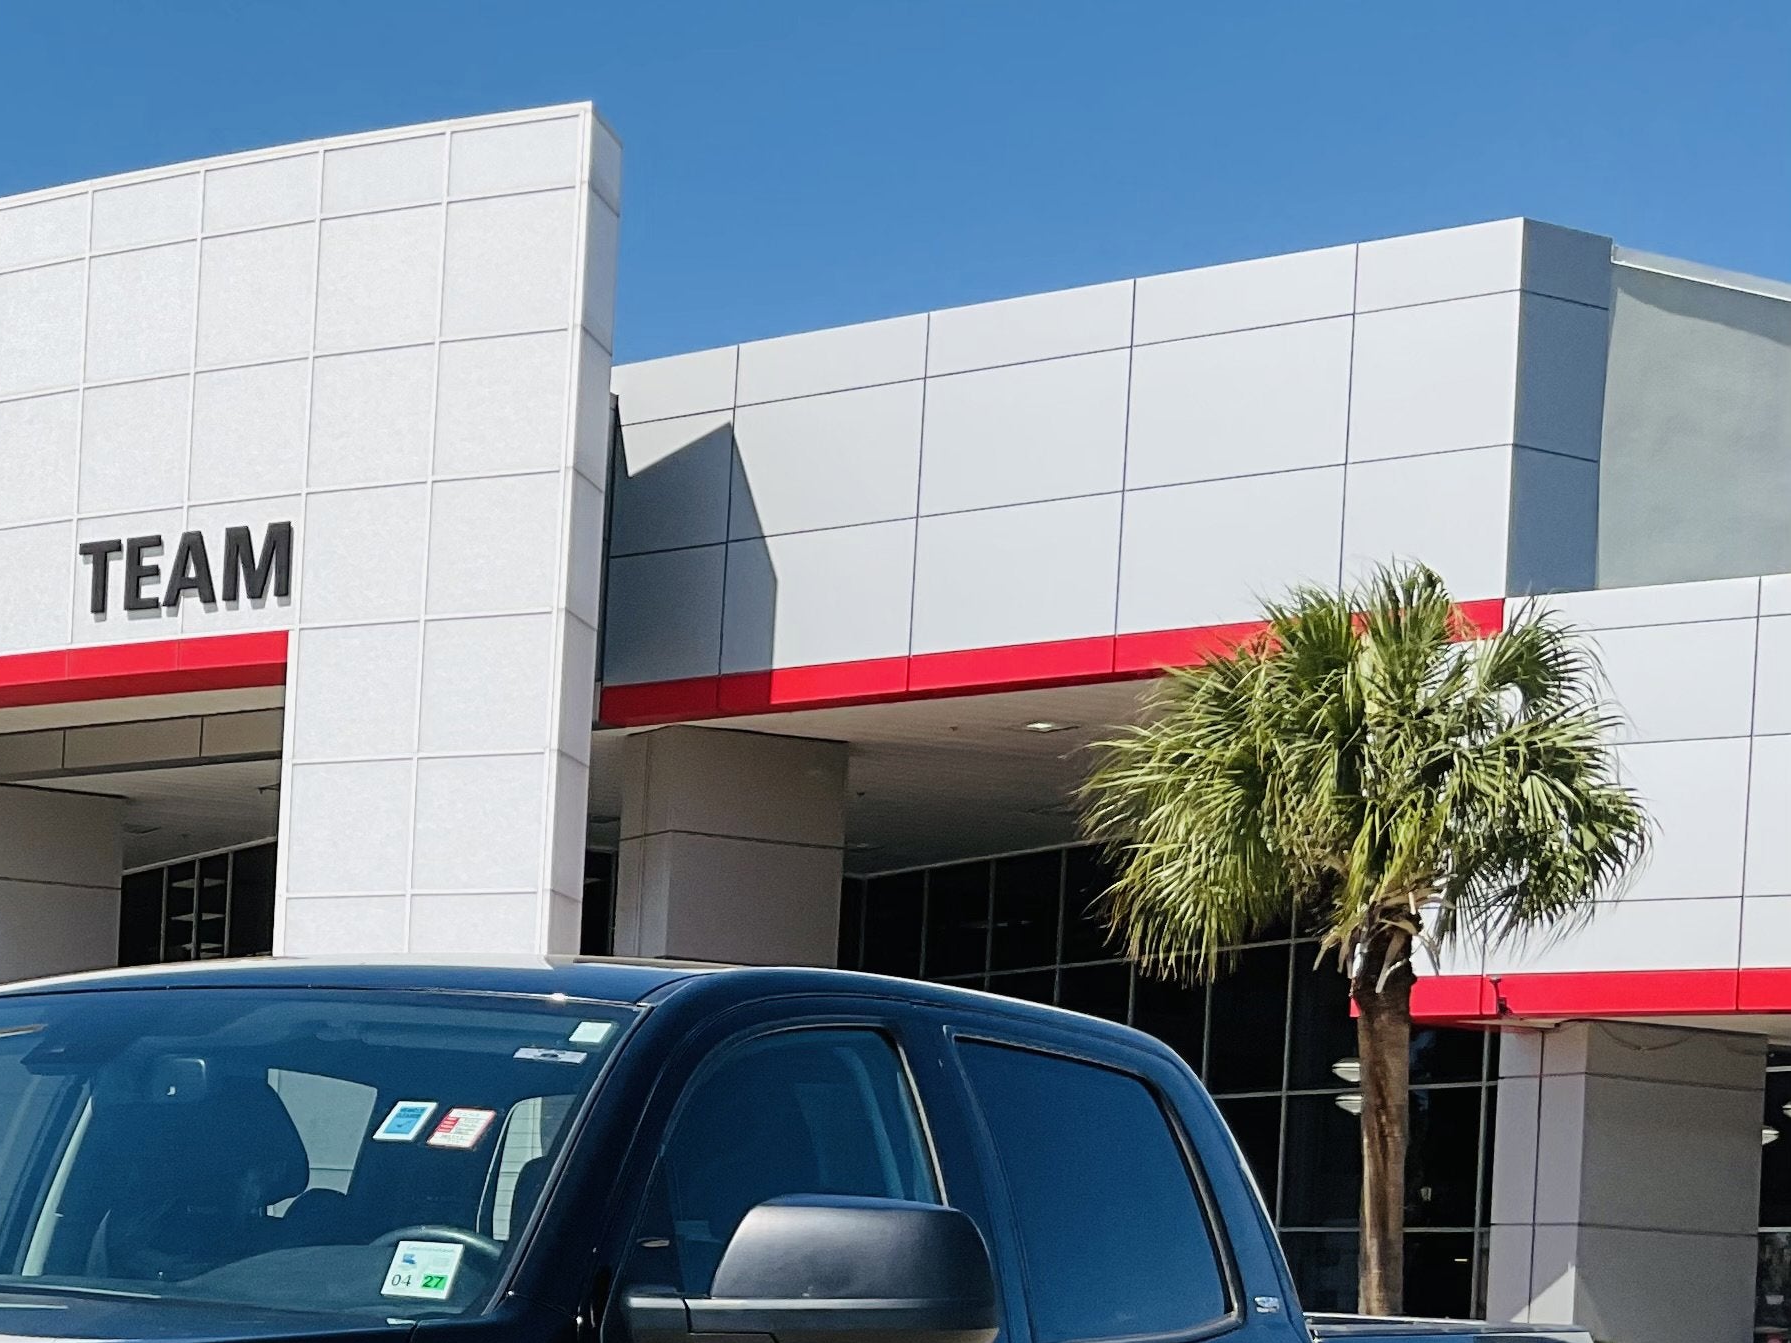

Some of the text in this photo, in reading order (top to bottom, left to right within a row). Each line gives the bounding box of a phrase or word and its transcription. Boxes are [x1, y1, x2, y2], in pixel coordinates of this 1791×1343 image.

[79, 521, 292, 615] TEAM
[391, 1274, 412, 1287] 04
[422, 1275, 445, 1288] 27
